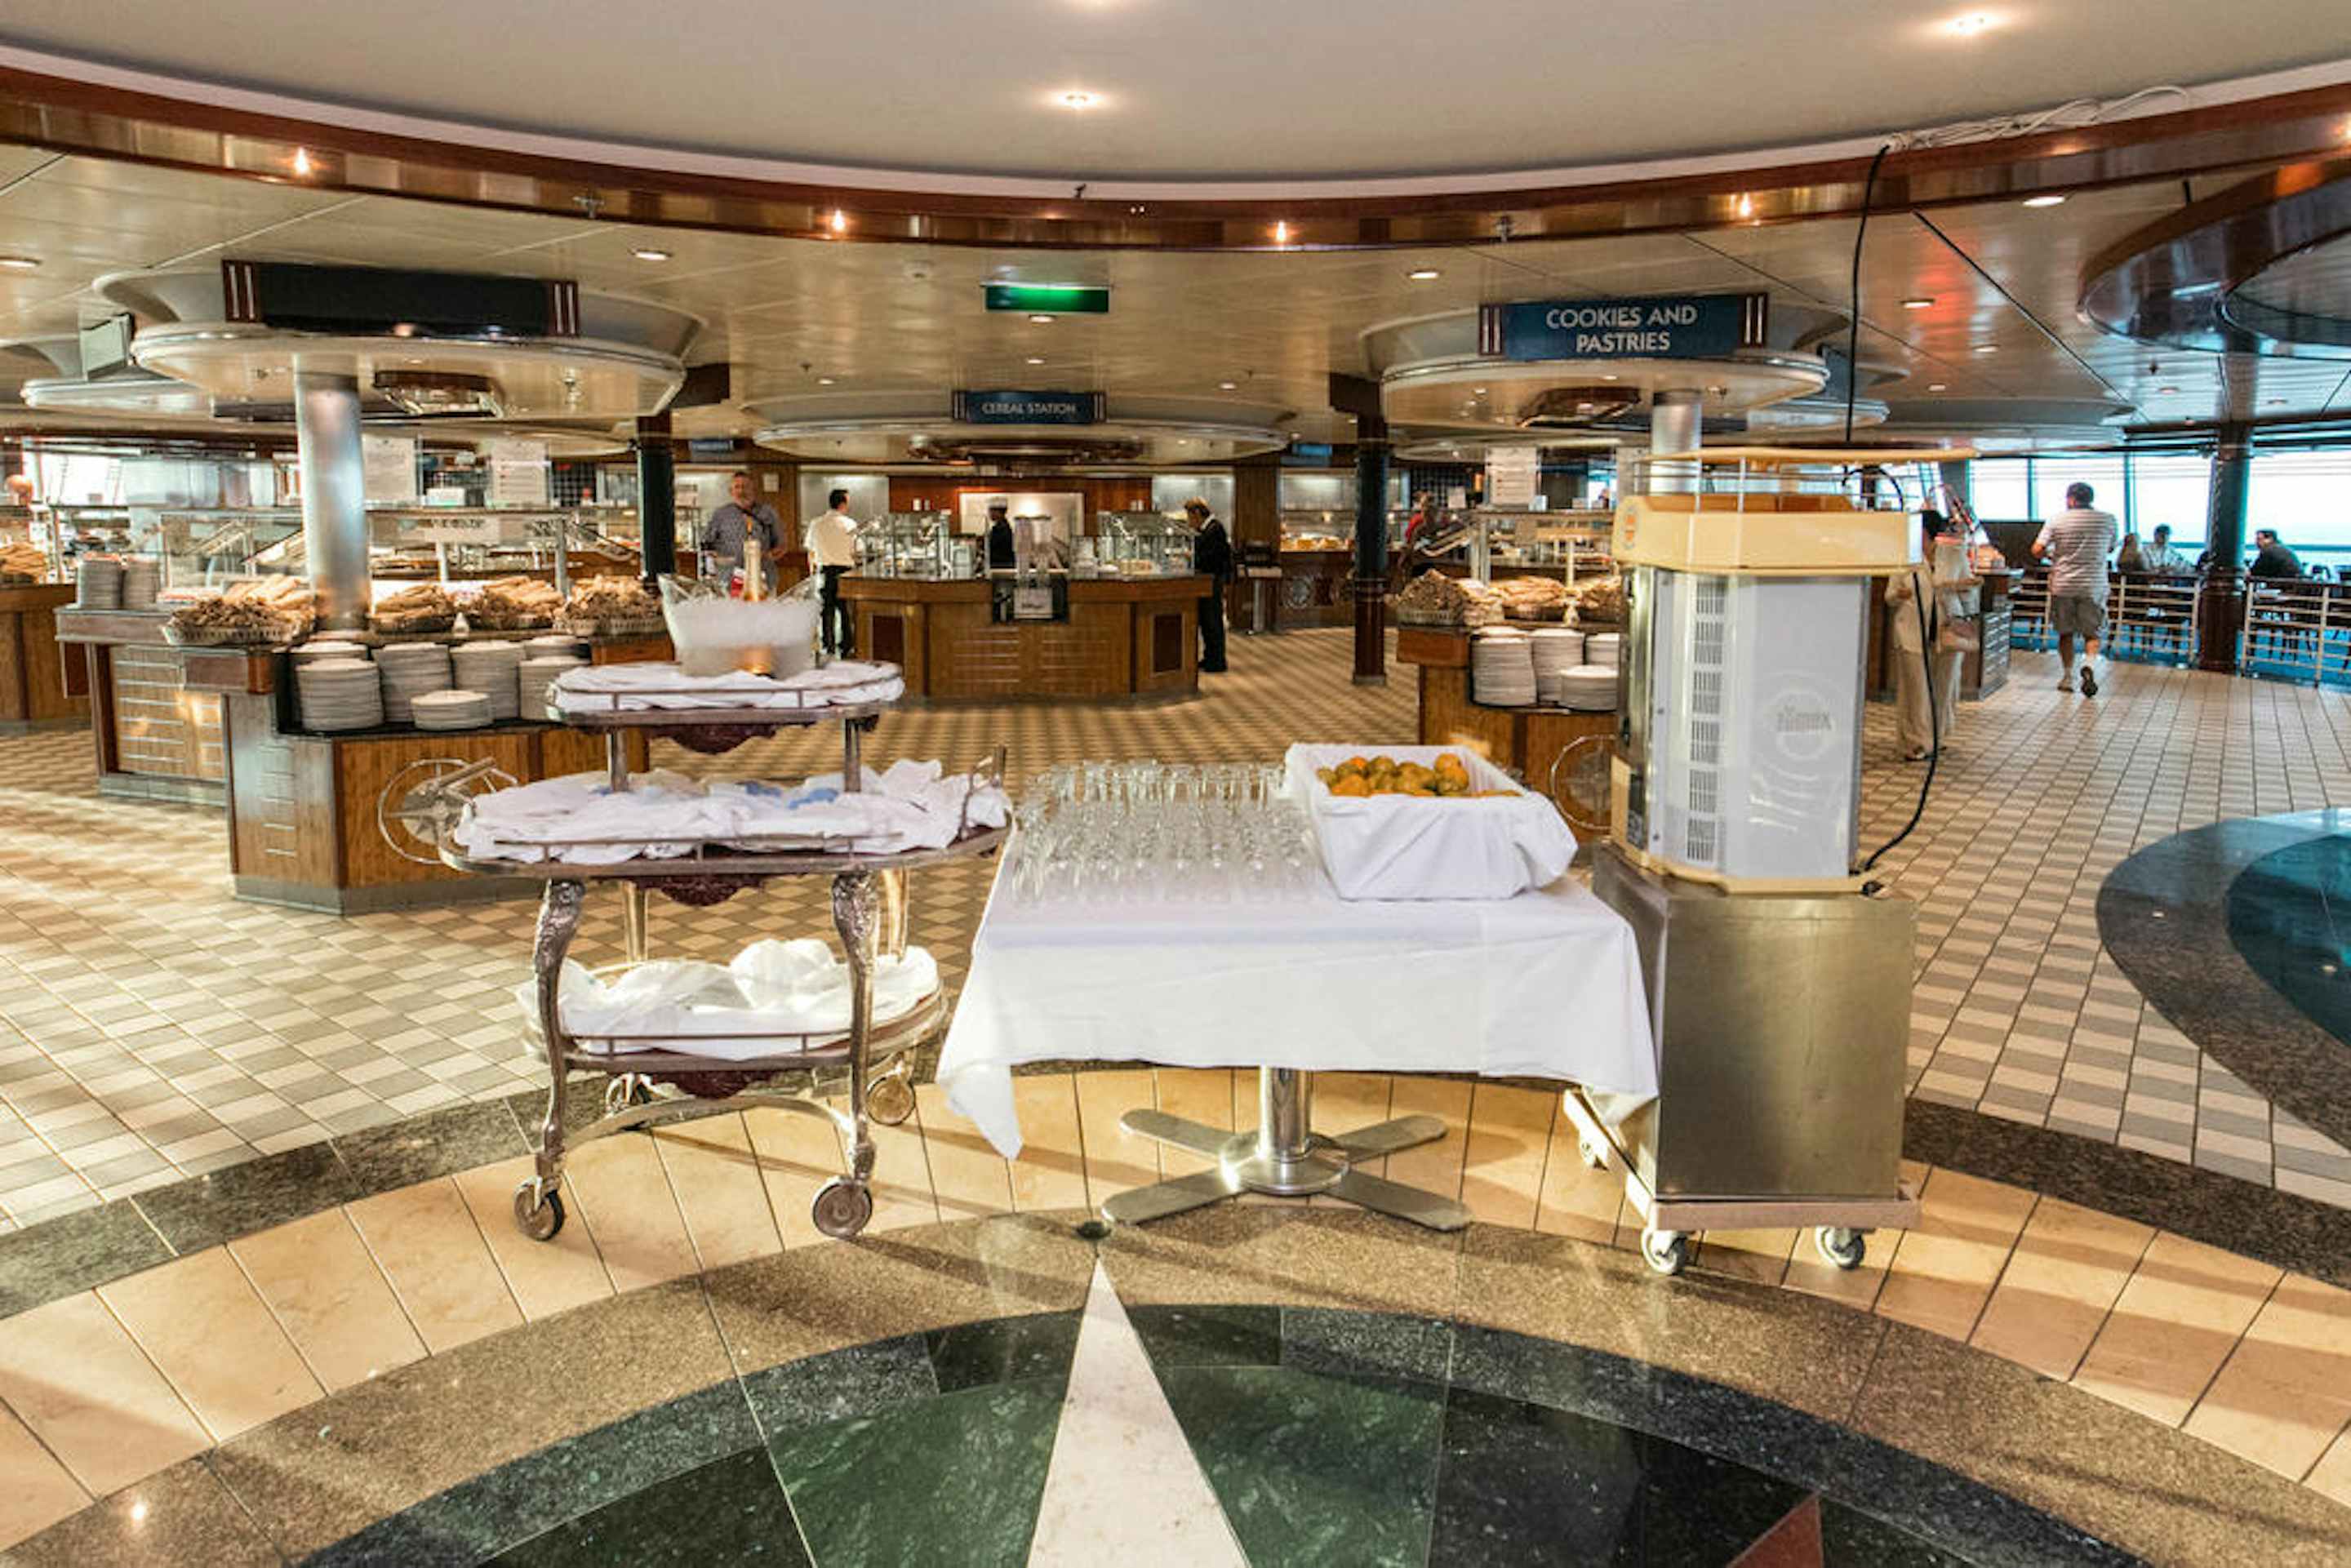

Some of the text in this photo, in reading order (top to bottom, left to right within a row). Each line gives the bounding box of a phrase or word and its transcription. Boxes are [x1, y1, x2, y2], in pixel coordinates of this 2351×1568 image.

[1545, 304, 1698, 328] COOKIES AND
[1575, 331, 1671, 353] PASTRIES
